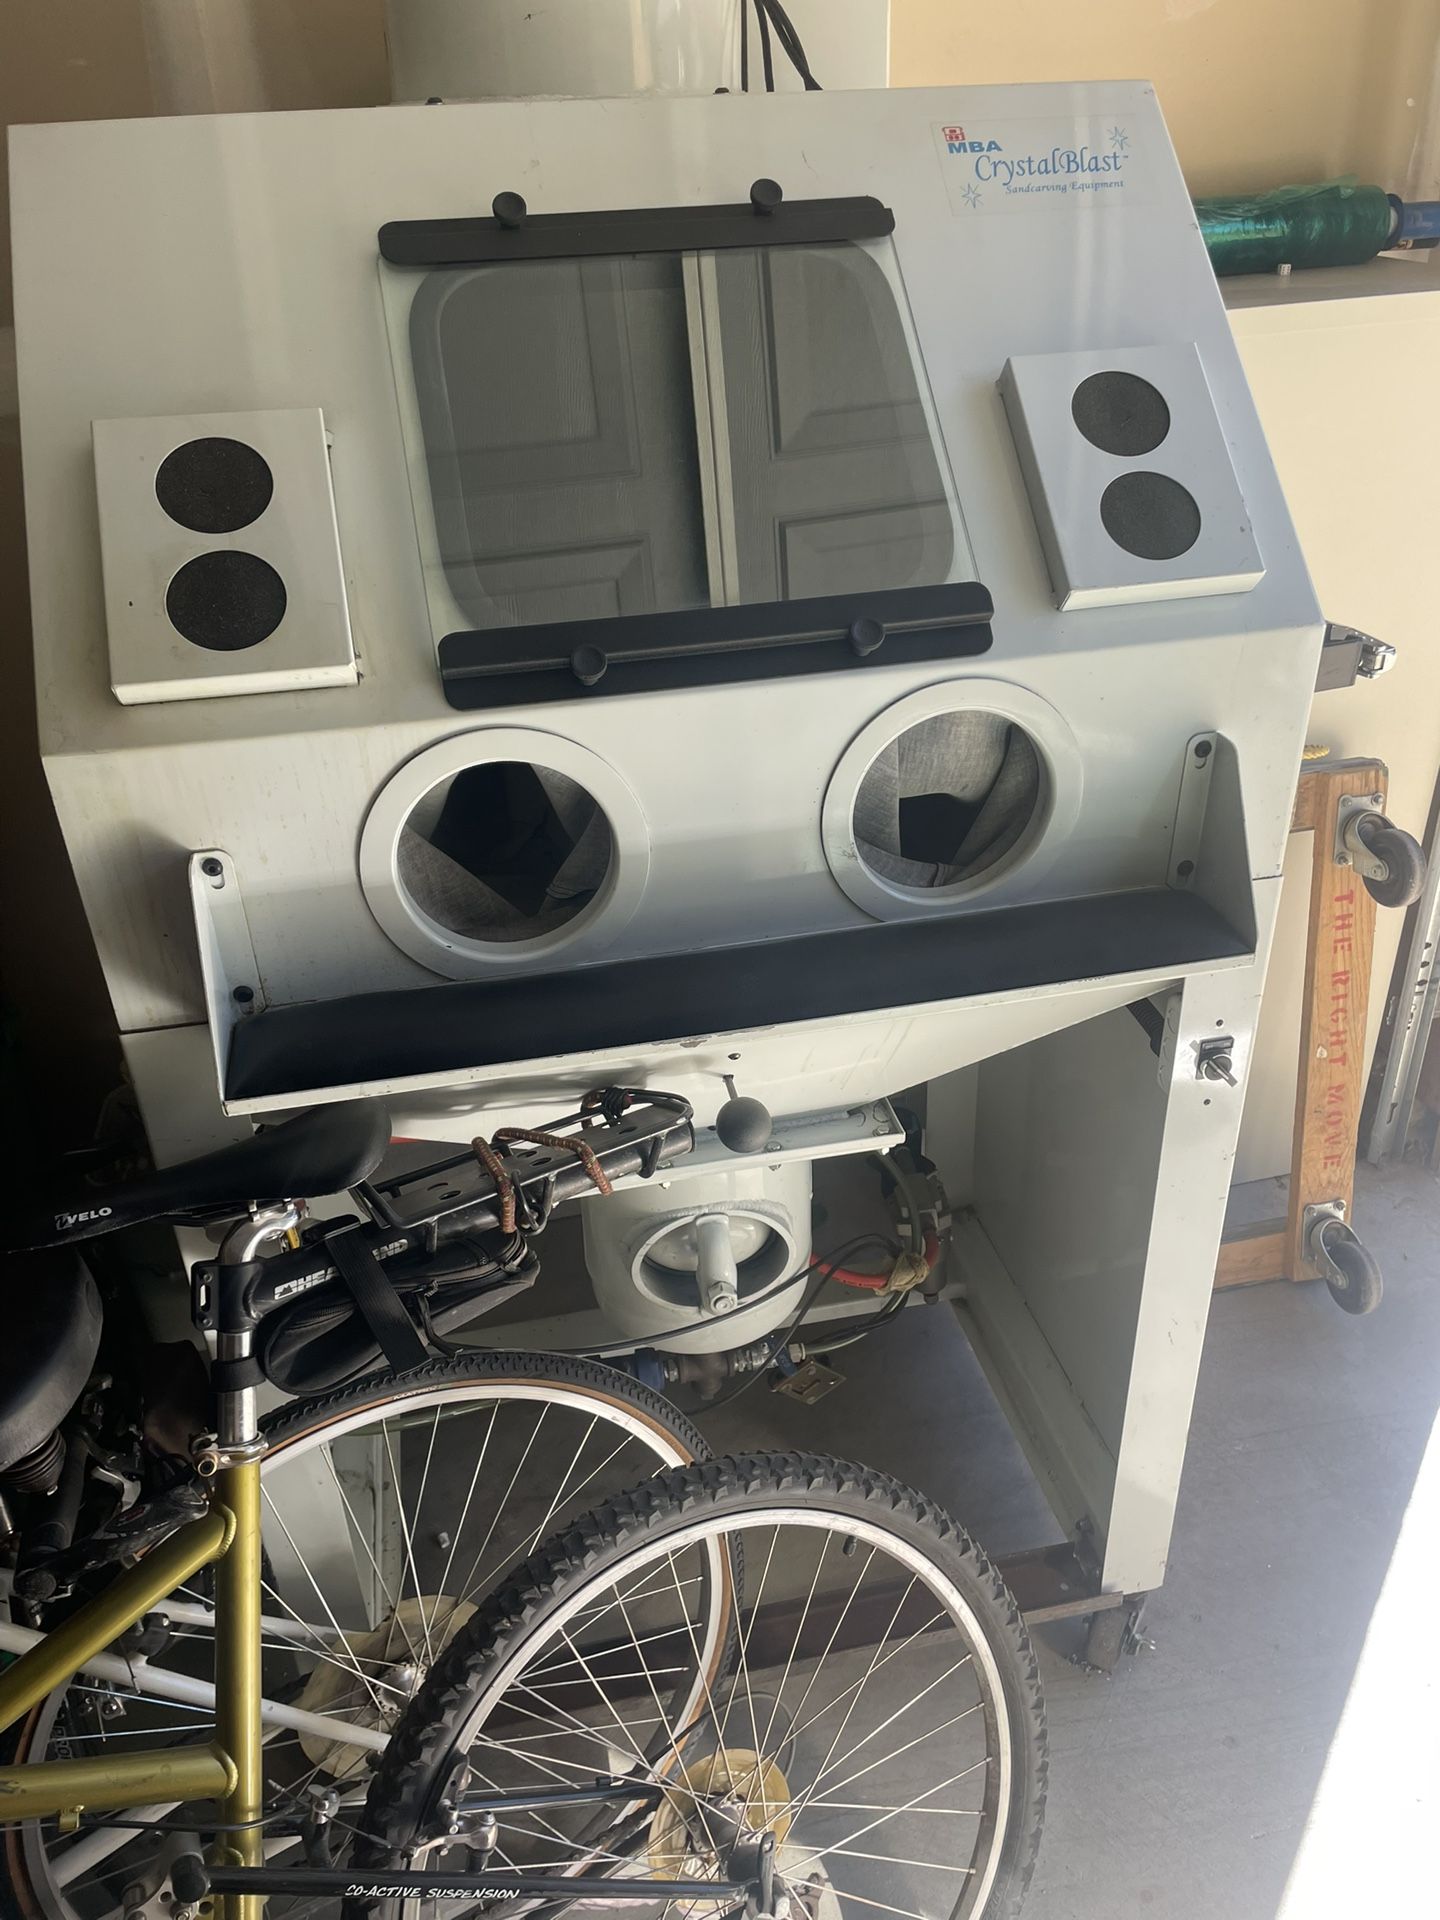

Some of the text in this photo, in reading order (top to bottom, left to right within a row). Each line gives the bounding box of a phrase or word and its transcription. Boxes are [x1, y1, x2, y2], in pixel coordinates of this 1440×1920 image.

[948, 140, 1003, 154] MBA
[1005, 179, 1125, 195] Sandcarving Equipment
[1323, 889, 1354, 1169] THE RIGHT MOVE
[67, 1207, 113, 1225] VELO
[345, 1884, 520, 1899] CO-ACTIVE SUSPENSION
